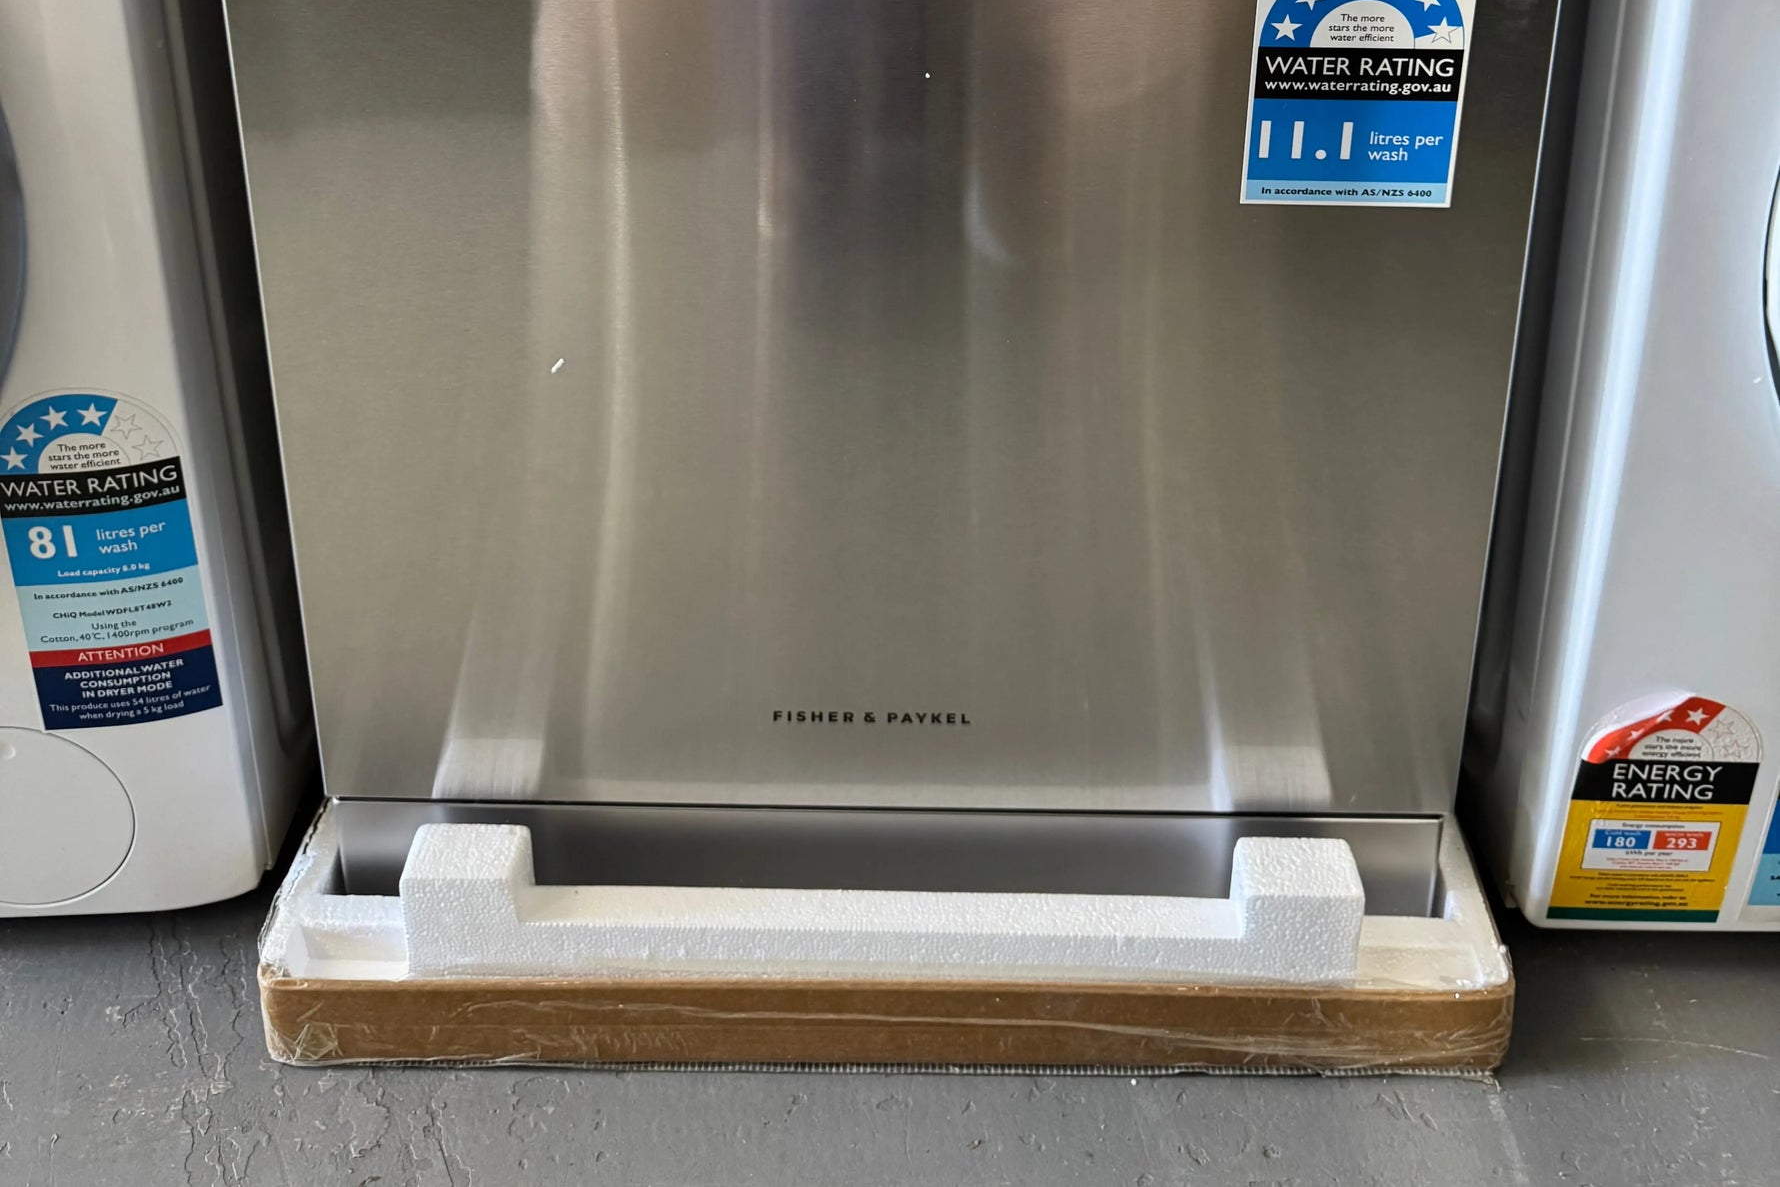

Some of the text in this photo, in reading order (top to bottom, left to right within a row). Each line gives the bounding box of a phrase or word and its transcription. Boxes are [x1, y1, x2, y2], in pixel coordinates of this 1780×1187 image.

[1340, 13, 1386, 23] The more
[1328, 23, 1395, 33] stars the more
[1330, 33, 1395, 43] water efficient
[1265, 56, 1455, 77] WATER RATING
[1264, 79, 1452, 96] www.waterrating.gov.au
[1258, 120, 1354, 160] 11.1
[1369, 130, 1444, 150] litres per
[1368, 147, 1409, 161] wash
[1261, 186, 1432, 198] In accordance with AS/NZS 6400
[48, 449, 120, 462] stars the more
[57, 442, 106, 453] The more
[50, 458, 121, 470] water efficient
[0, 465, 178, 498] WATER RATING
[4, 485, 180, 512] www.waterrating.gov.au
[96, 521, 166, 541] litres per
[28, 525, 78, 560] 81
[98, 540, 138, 554] wash
[57, 562, 151, 578] Load capacity 8.0 kg
[34, 576, 184, 601] In accordance with AS/NZS 6400
[52, 611, 78, 619] CHiQ
[79, 610, 105, 618] Model
[40, 634, 79, 644] Cotton,
[107, 628, 151, 640] 1400rpm
[152, 618, 194, 636] program
[91, 619, 137, 631] Using the
[78, 643, 164, 662] ATTENTION
[64, 658, 185, 681] ADDITIONAL WATER
[79, 671, 172, 689] CONSUMPTION
[50, 703, 69, 712] This
[110, 700, 130, 708] uses
[132, 697, 145, 706] 54
[145, 694, 169, 704] litres
[171, 690, 182, 699] of
[183, 684, 212, 698] water
[82, 681, 173, 698] IN DRYER MODE
[79, 711, 103, 720] when
[105, 708, 135, 720] drying
[143, 706, 149, 714] 5
[150, 704, 162, 715] kg
[163, 700, 185, 710] load
[772, 710, 971, 724] FISHER & PAYKEL
[1656, 735, 1671, 743] The
[1612, 763, 1723, 782] ENERGY
[1611, 782, 1715, 800] RATING
[1606, 836, 1636, 848] 180
[1666, 837, 1698, 849] 293
